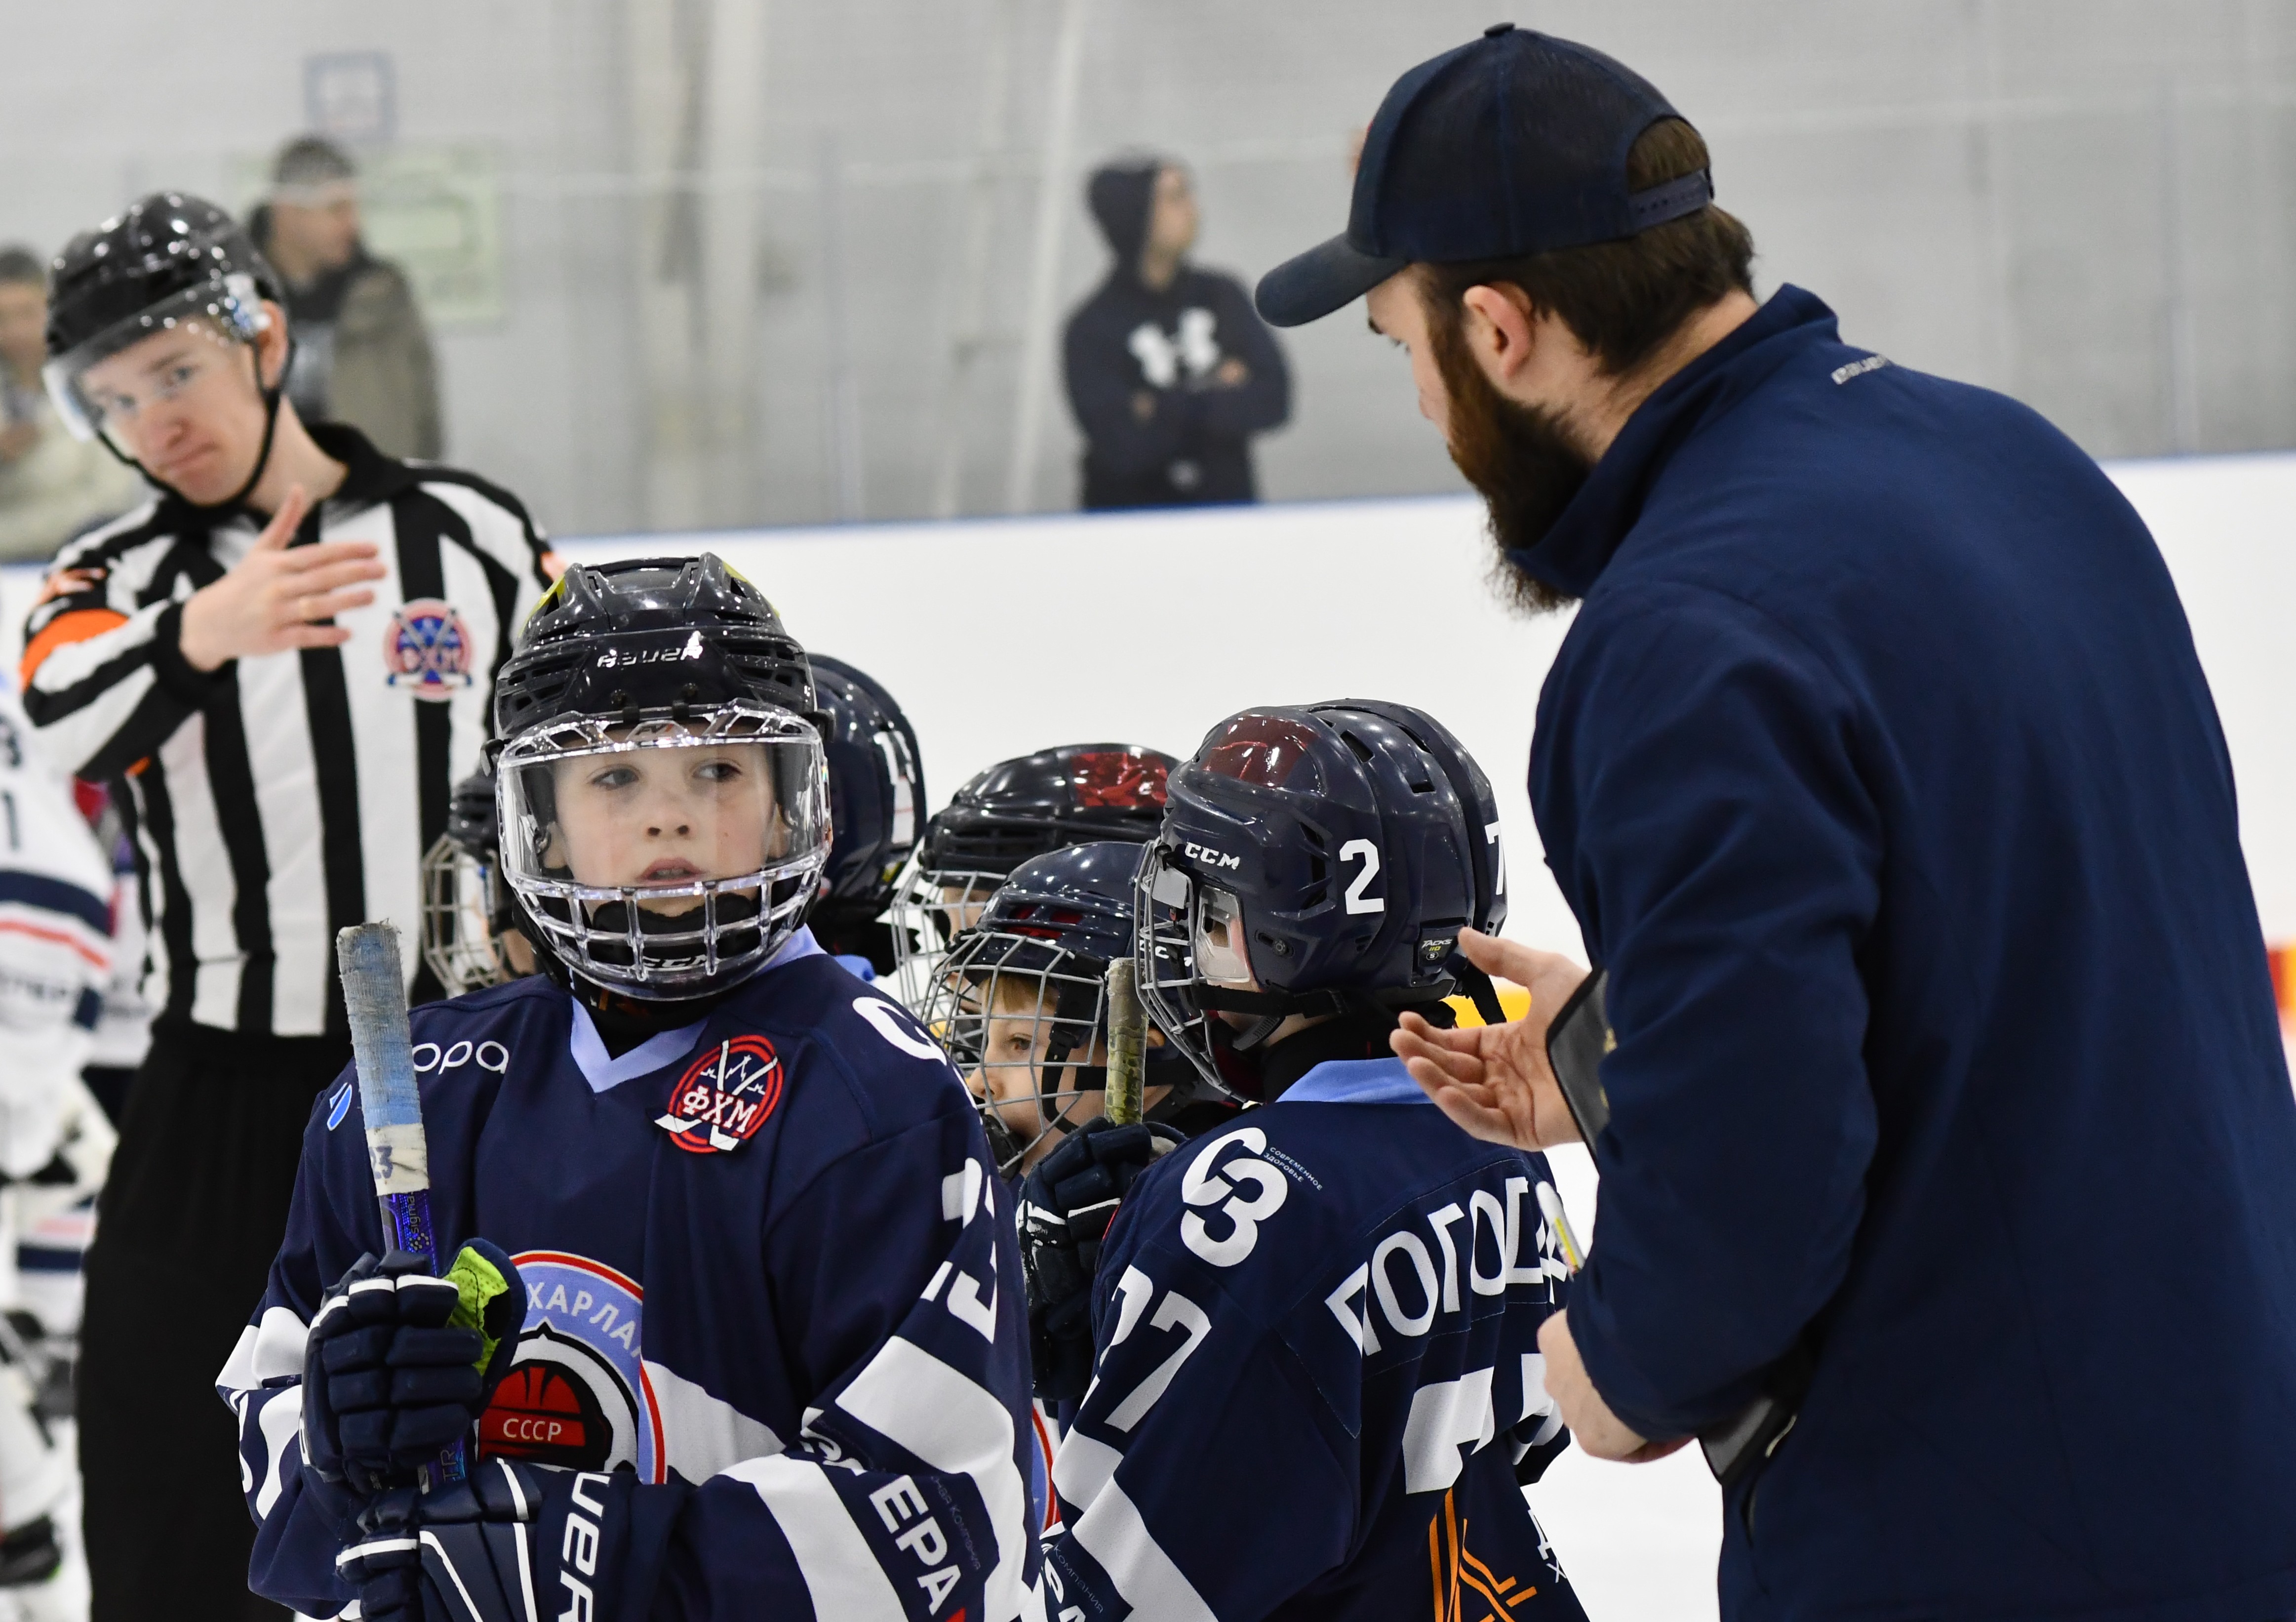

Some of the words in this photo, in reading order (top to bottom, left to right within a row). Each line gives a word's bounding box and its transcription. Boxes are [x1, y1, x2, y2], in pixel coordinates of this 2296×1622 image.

[1185, 842, 1241, 871] CCM
[1339, 839, 1384, 915] 2
[1422, 938, 1453, 949] TACKS
[682, 1084, 758, 1133] ФХМ
[1264, 1152, 1305, 1182] ЗДОРОВЬЕ
[1269, 1147, 1323, 1191] СОВРЕМЕННОЕ
[503, 1418, 562, 1442] СССР
